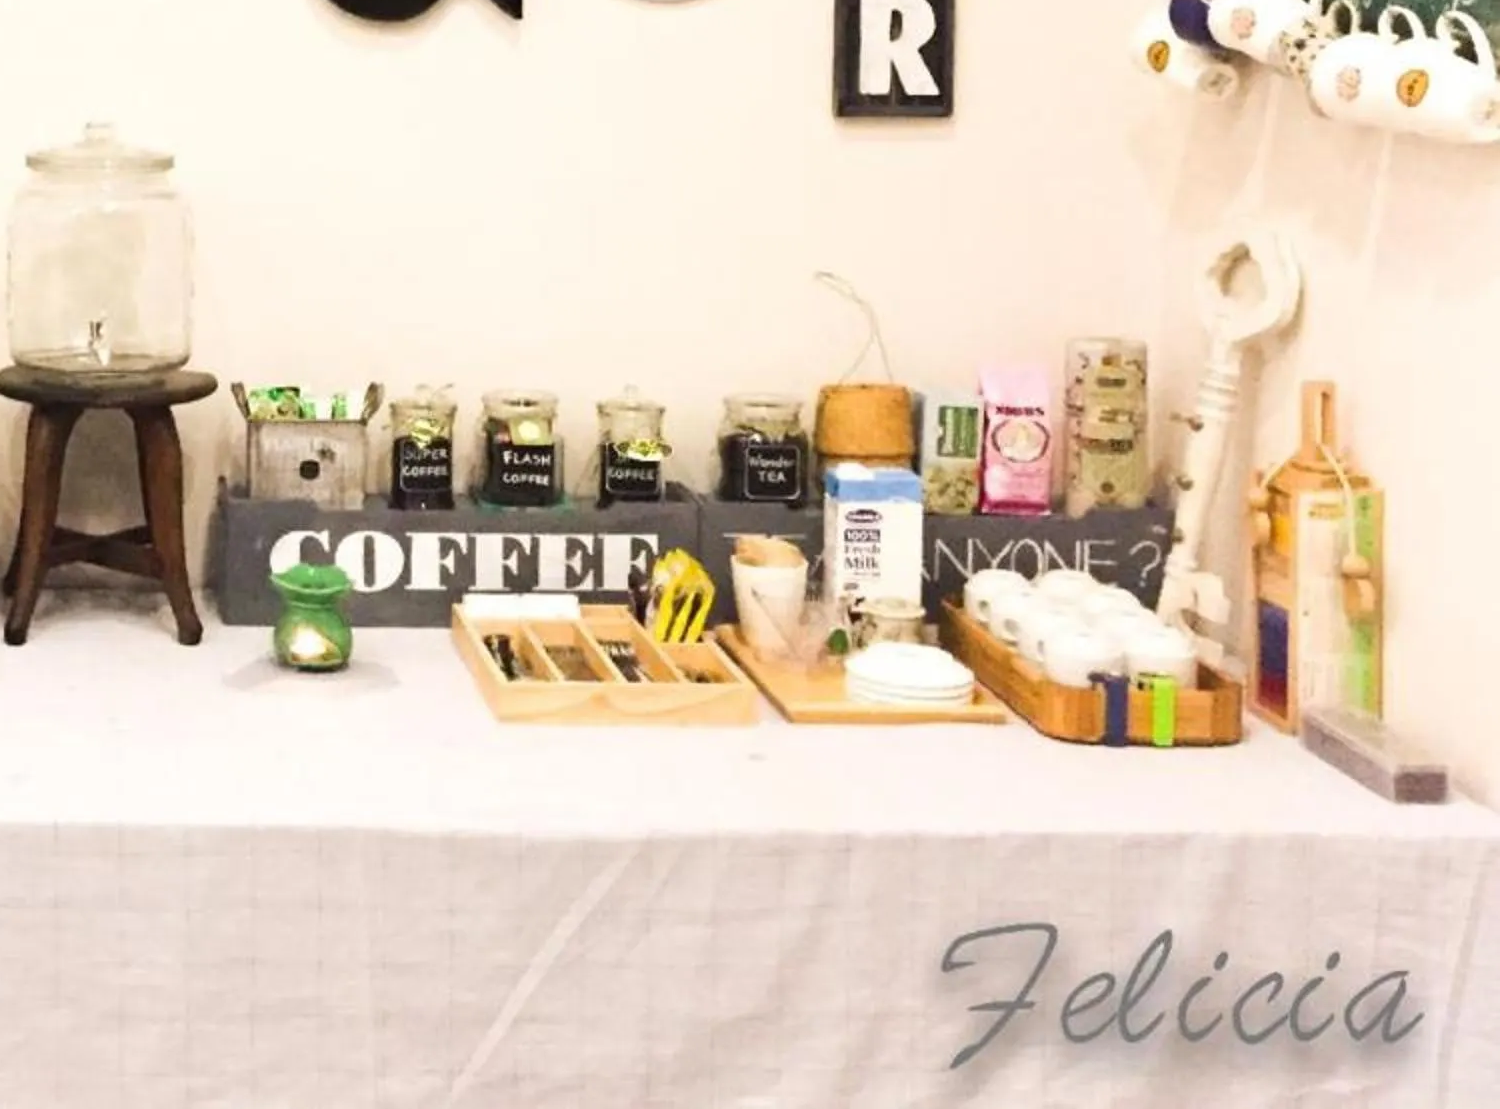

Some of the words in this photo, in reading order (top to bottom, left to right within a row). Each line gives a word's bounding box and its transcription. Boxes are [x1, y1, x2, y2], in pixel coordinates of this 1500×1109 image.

[403, 447, 449, 462] SUPER
[502, 449, 551, 467] FLASH
[401, 465, 449, 477] COFFEE
[757, 470, 787, 484] TEA
[502, 472, 550, 487] COFFEE
[844, 543, 881, 555] Fresh
[844, 557, 879, 570] Milk
[921, 537, 1119, 583] NYONE
